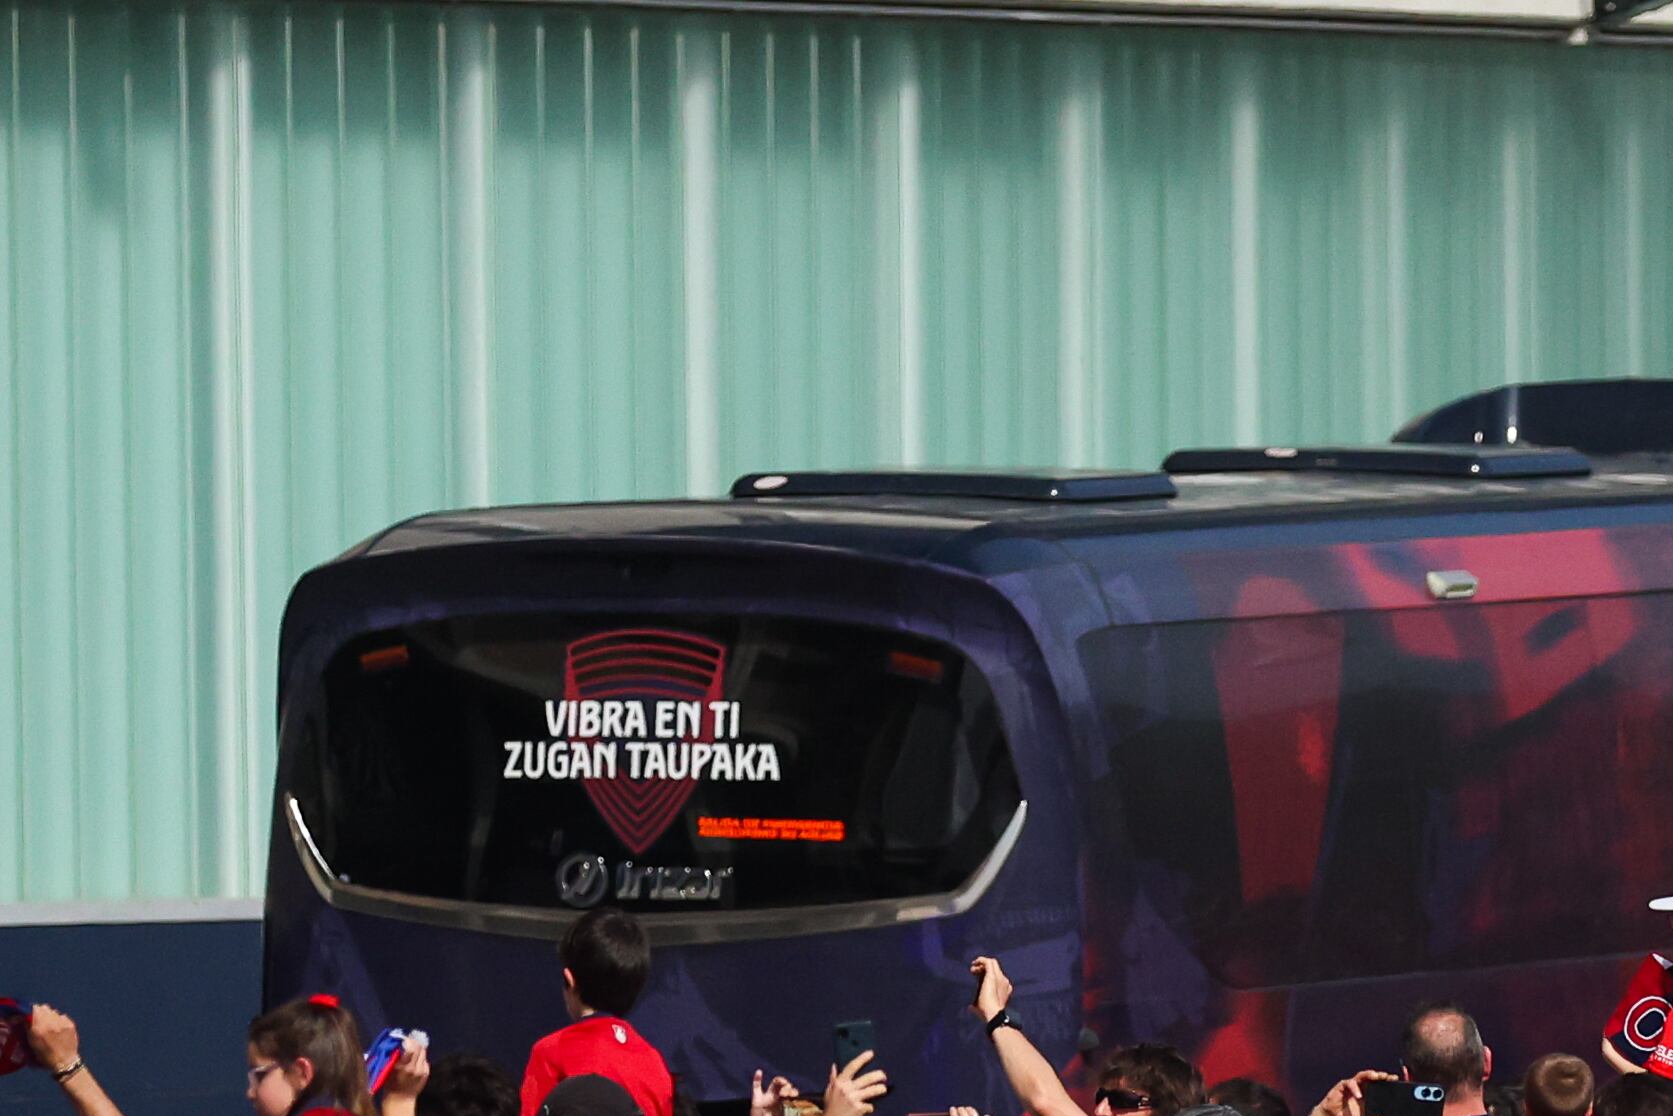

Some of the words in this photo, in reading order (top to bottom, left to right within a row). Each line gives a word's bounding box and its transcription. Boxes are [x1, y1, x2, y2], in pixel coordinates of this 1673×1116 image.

[545, 699, 648, 739] VIBRA
[655, 700, 702, 740] EN
[708, 701, 740, 740] TI
[503, 740, 618, 780] ZUGAN
[624, 741, 781, 781] TAUPAKA
